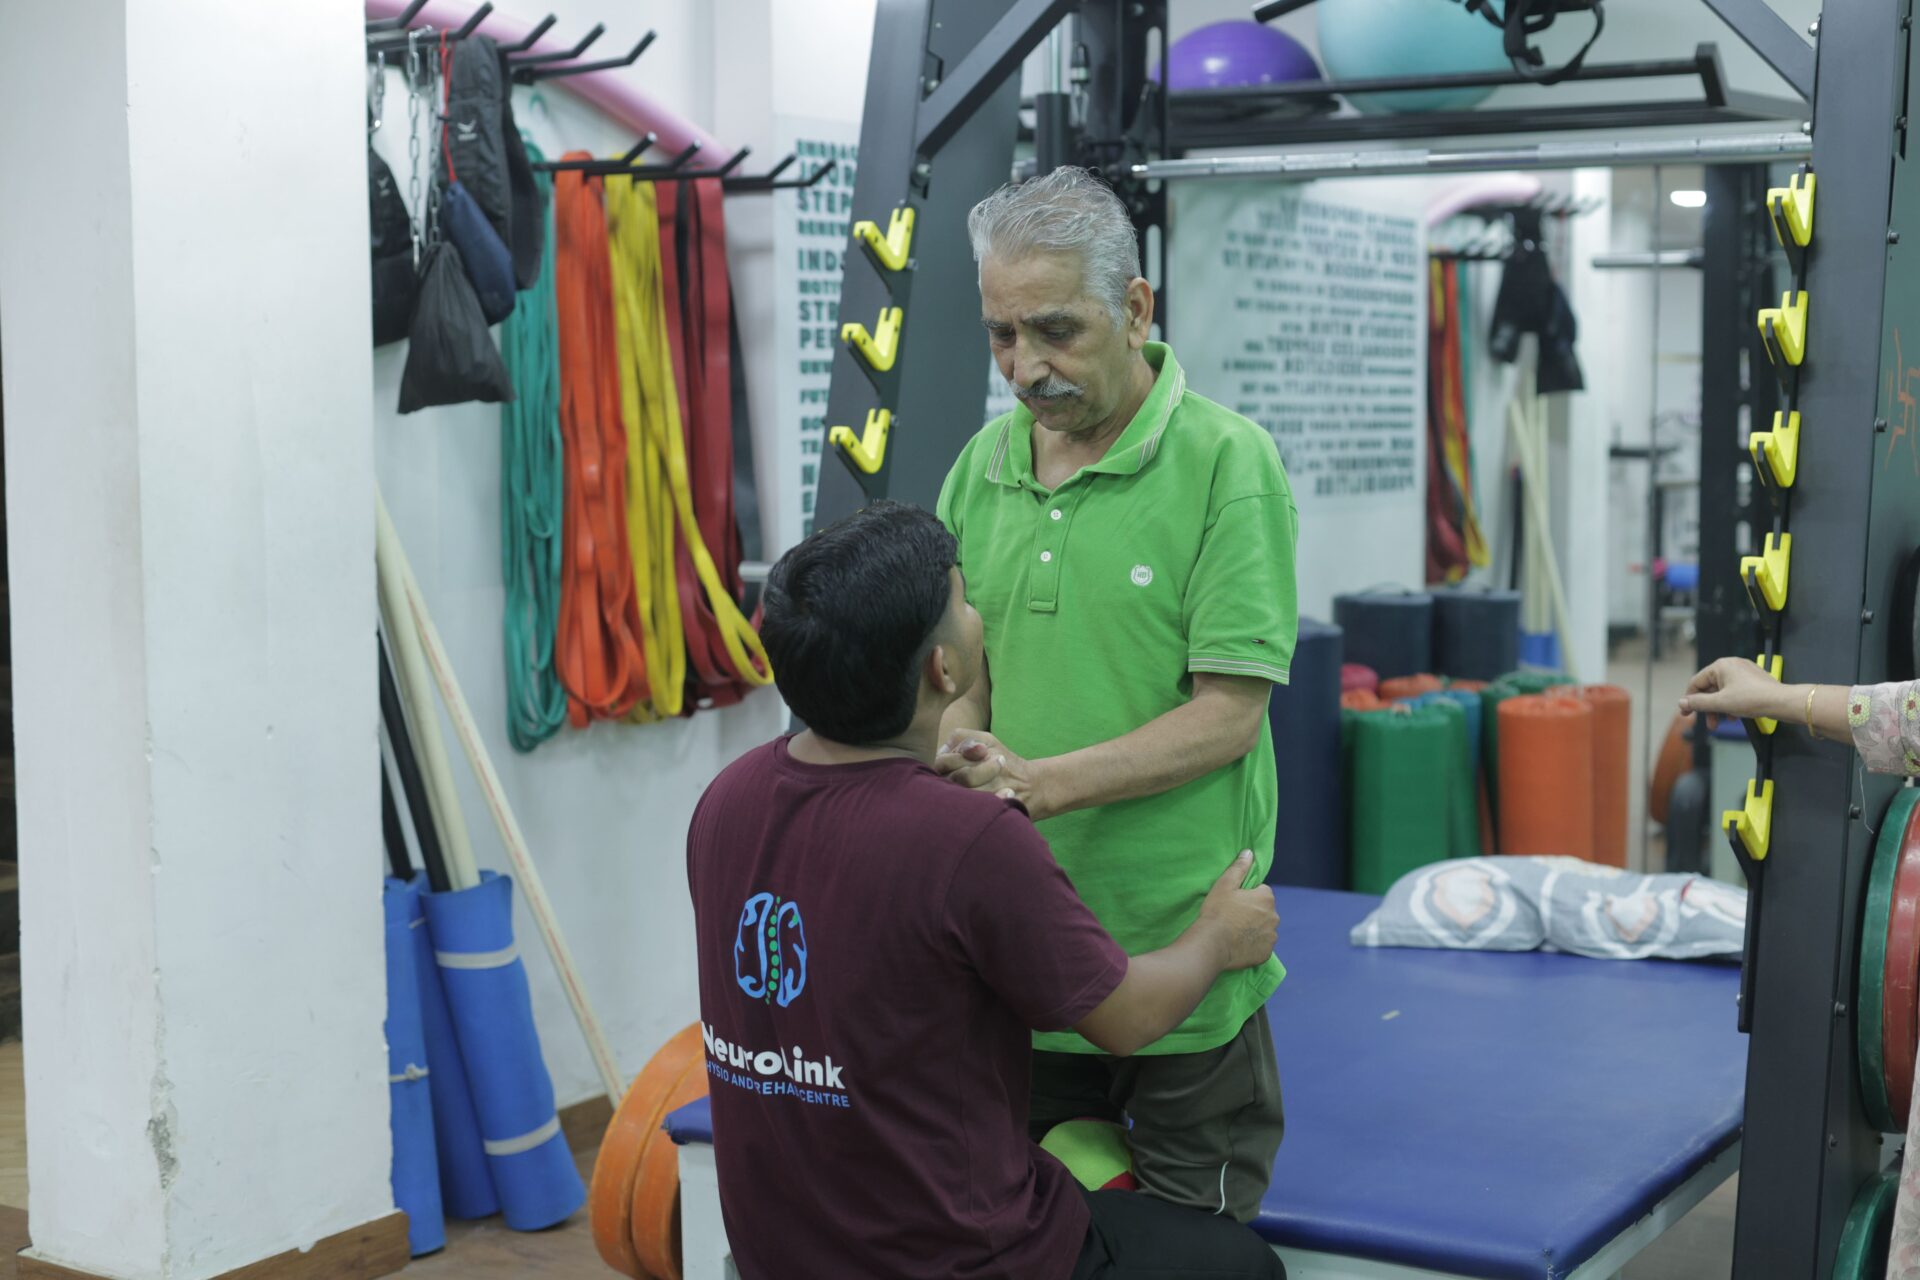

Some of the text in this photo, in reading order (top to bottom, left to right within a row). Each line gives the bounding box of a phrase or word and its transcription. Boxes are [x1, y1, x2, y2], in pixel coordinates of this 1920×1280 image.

[706, 1060, 730, 1082] HYSIO
[731, 1073, 754, 1091] AND
[799, 1090, 851, 1108] CENTRE
